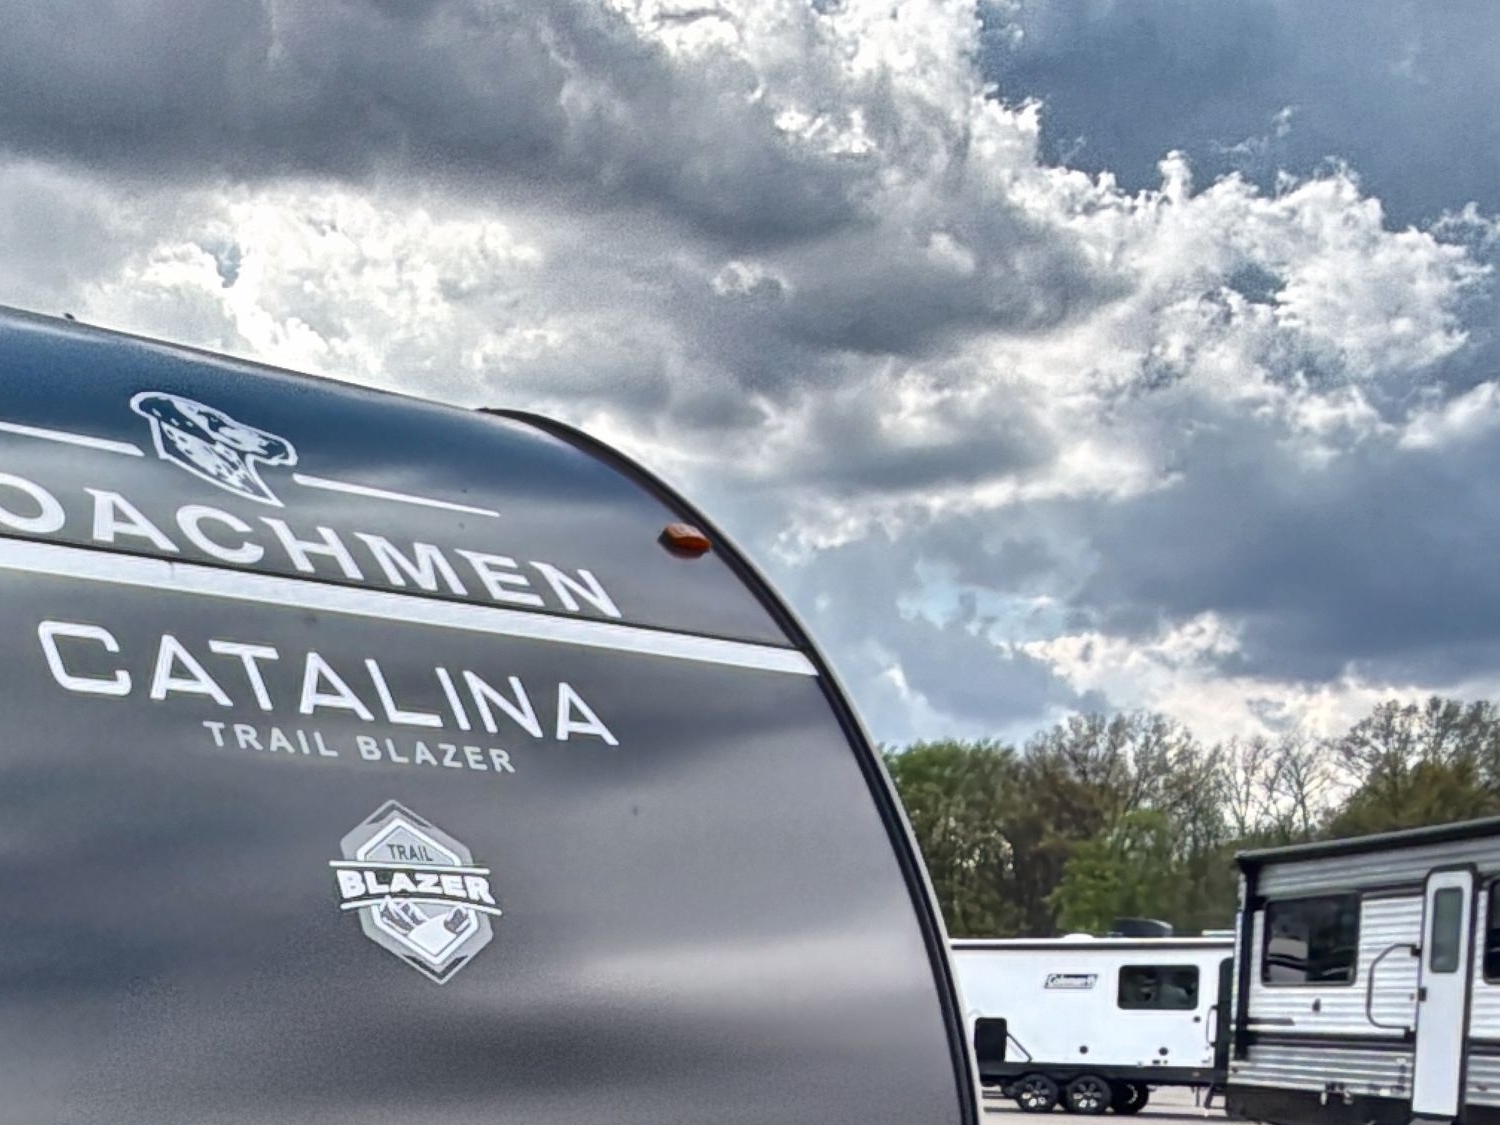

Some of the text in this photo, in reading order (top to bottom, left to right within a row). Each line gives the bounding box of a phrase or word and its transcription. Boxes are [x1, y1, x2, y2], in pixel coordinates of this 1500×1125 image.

[38, 620, 619, 746] CATALINA
[202, 720, 516, 774] TRAIL BLAZER
[387, 843, 434, 862] TRAIL
[336, 869, 496, 905] BLAZER
